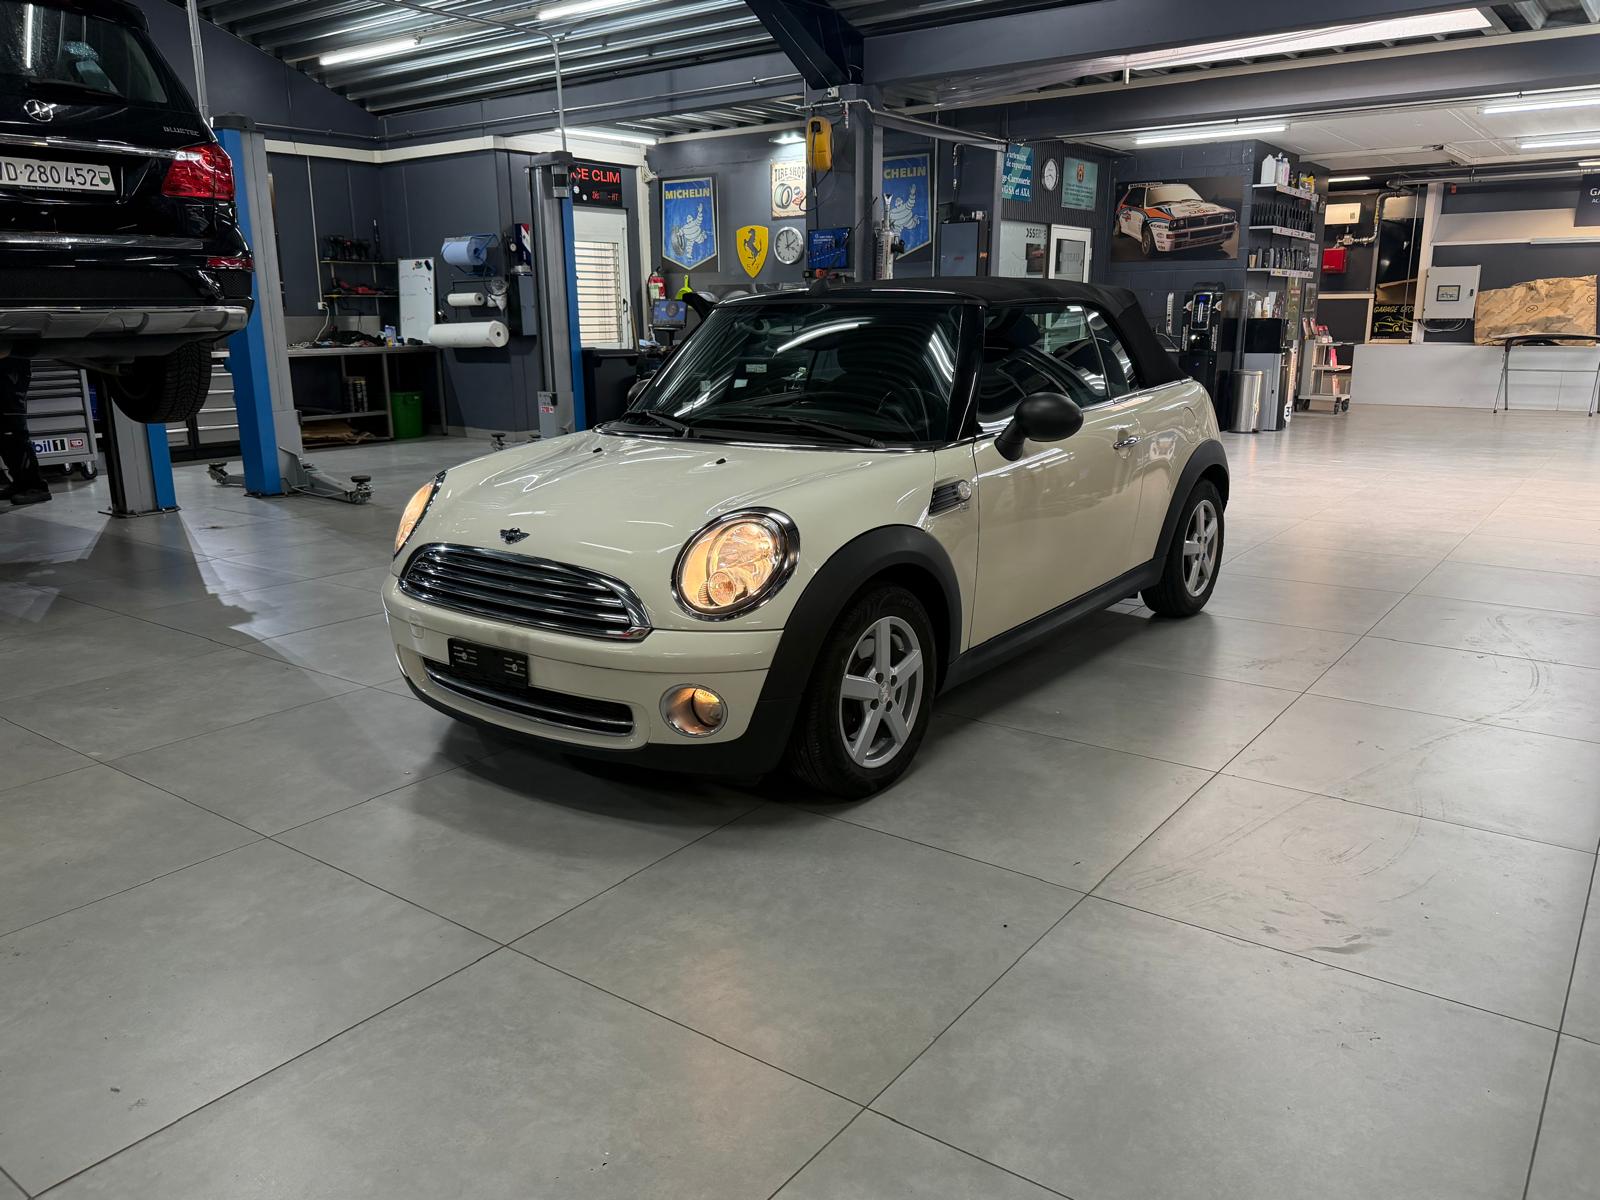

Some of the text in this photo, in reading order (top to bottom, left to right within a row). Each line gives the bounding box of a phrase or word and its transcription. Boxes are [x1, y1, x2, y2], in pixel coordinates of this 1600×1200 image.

[592, 170, 620, 183] CLIM
[775, 166, 805, 182] TIRE SHOP
[884, 166, 926, 179] CHELIN
[665, 187, 710, 200] MICHELIN
[1020, 187, 1031, 198] AXA
[1374, 305, 1399, 313] GARAGE
[32, 440, 51, 453] bil
